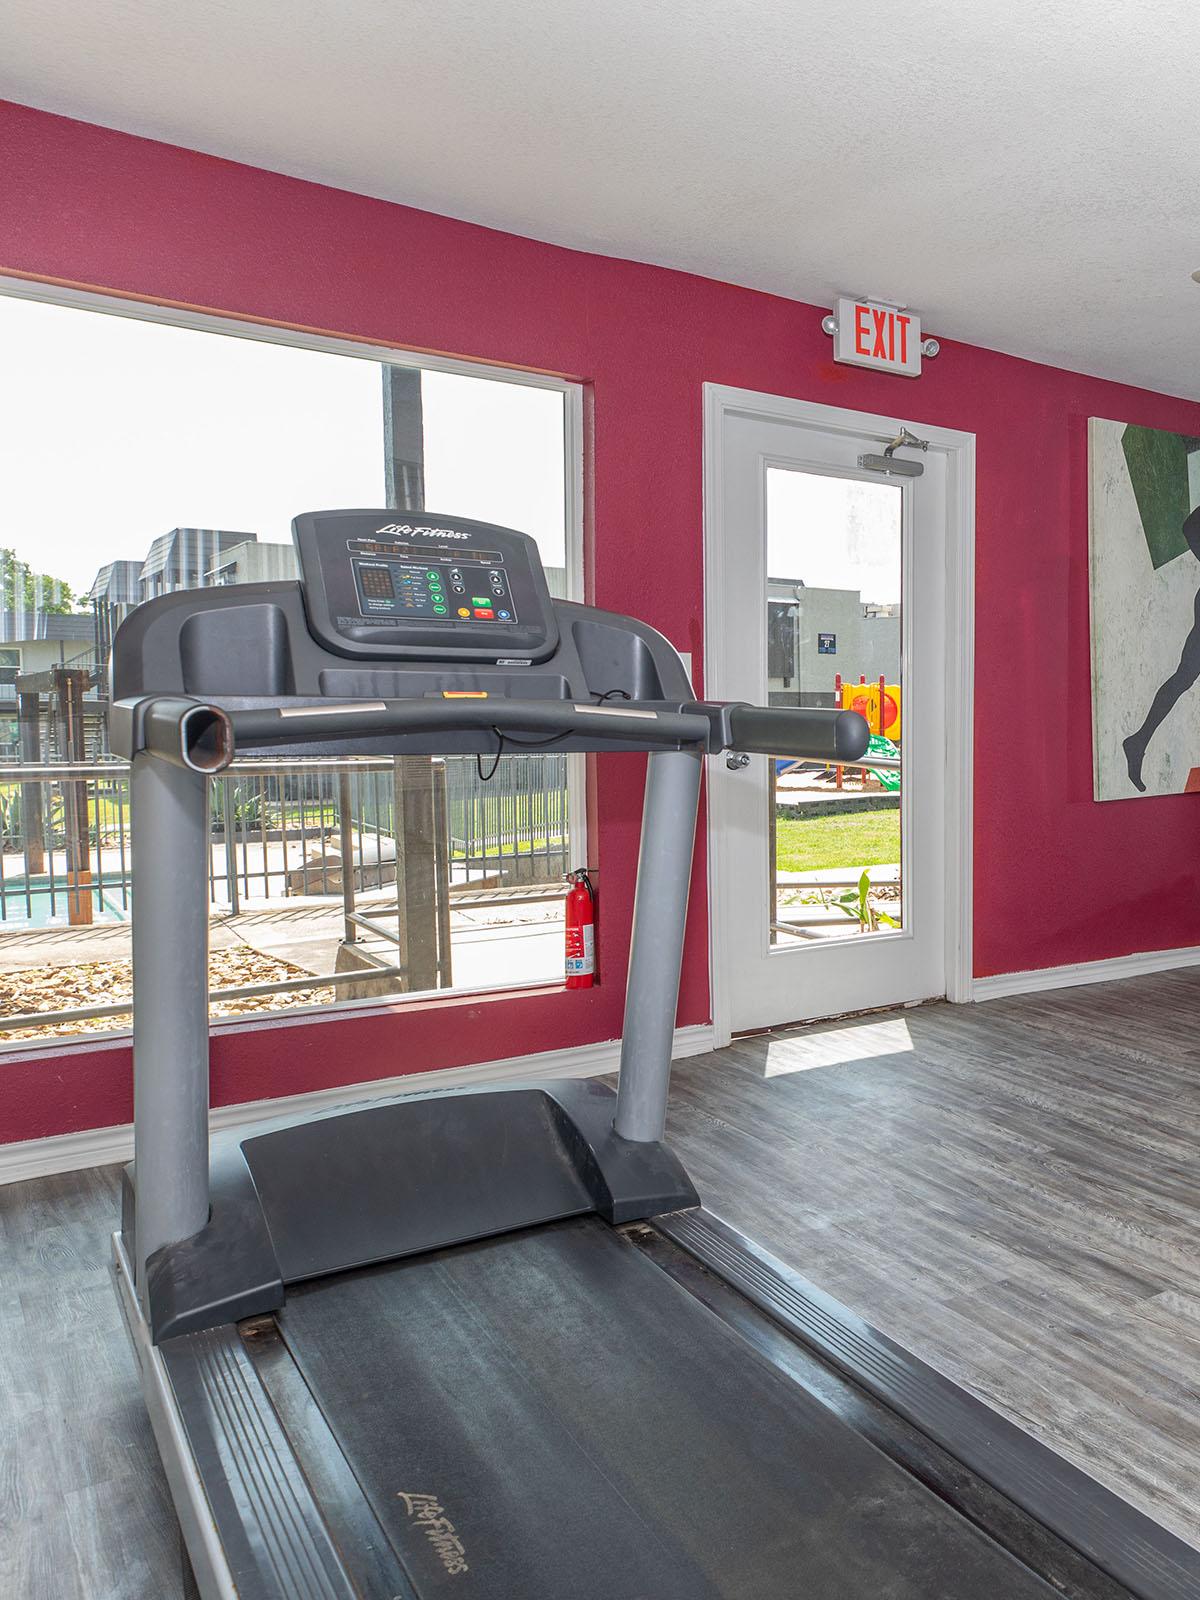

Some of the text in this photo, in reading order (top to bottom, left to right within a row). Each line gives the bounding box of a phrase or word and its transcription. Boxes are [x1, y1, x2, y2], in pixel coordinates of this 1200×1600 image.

[855, 304, 911, 364] EXIT
[375, 523, 470, 541] Life Fitness
[396, 1491, 469, 1575] Life Fitness
